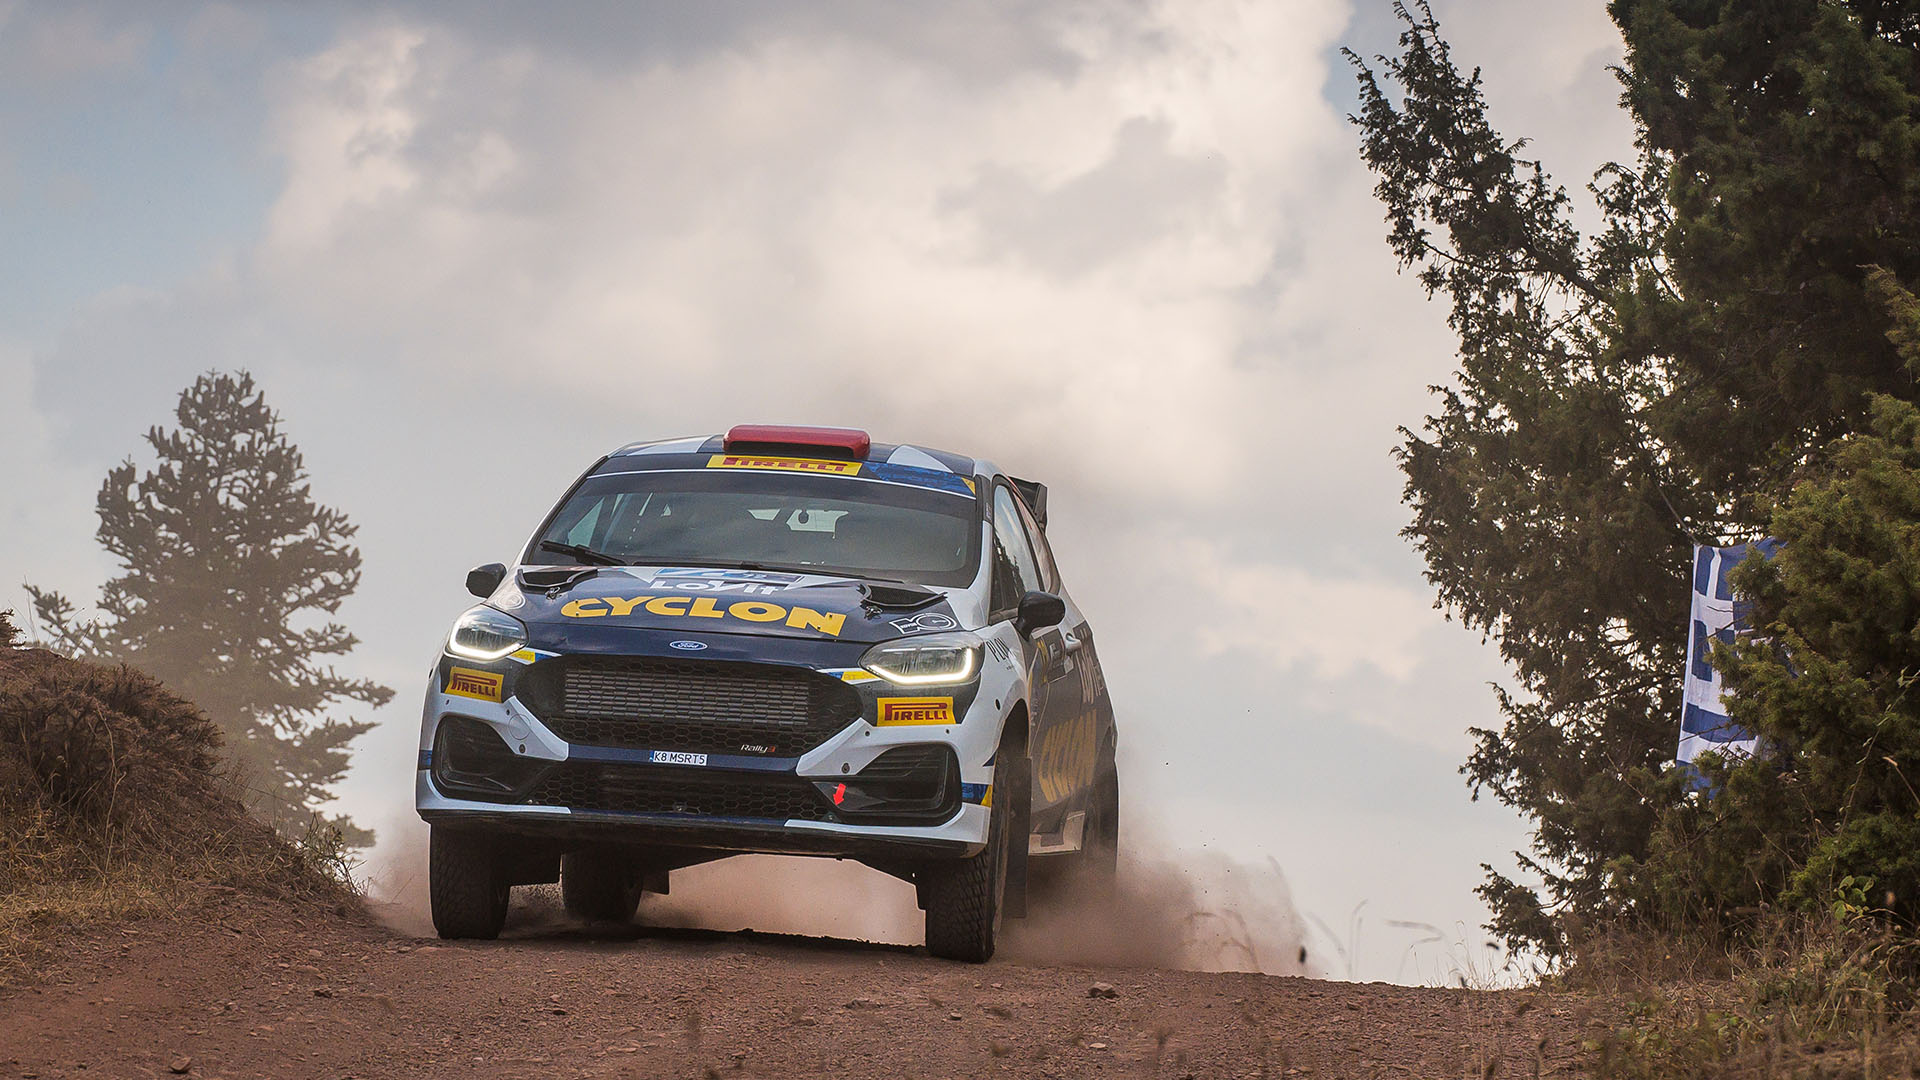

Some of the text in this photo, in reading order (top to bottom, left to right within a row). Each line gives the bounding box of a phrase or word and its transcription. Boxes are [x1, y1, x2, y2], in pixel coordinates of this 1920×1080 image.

[722, 456, 848, 472] PIRELLI
[560, 596, 847, 637] CYCLON
[451, 673, 497, 696] PIRELLI
[885, 703, 948, 721] PIRELLI
[654, 752, 667, 761] K8
